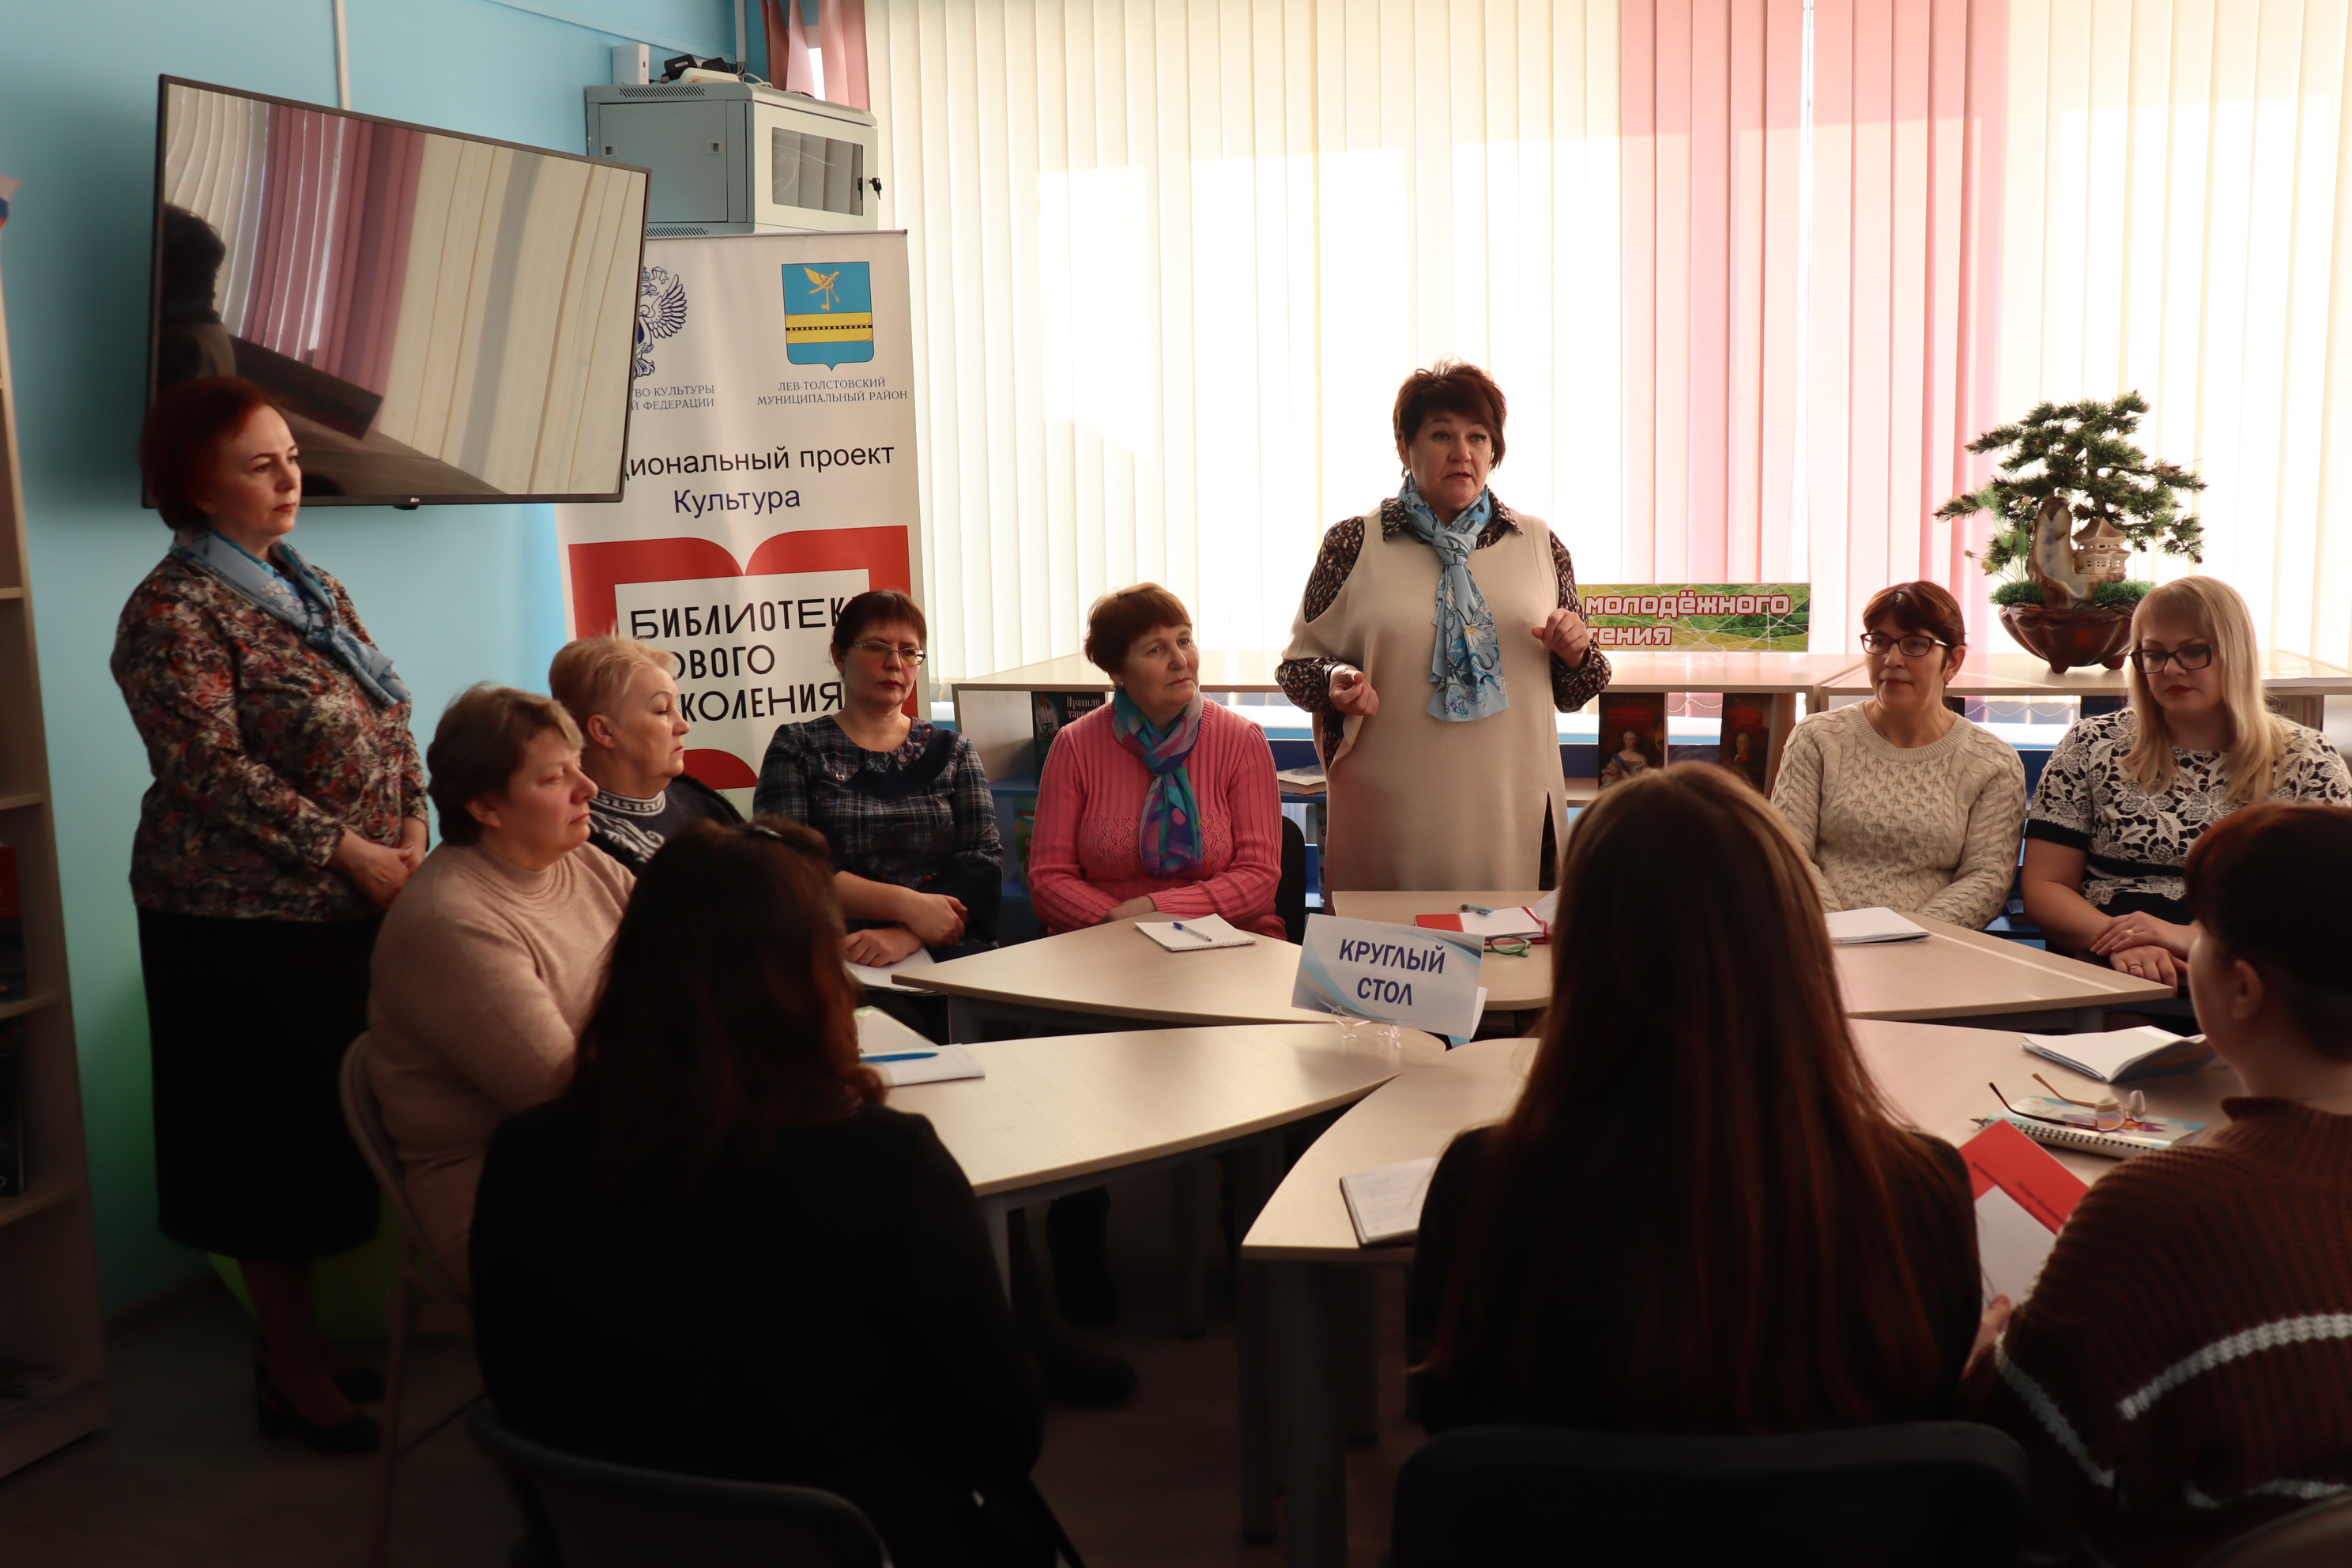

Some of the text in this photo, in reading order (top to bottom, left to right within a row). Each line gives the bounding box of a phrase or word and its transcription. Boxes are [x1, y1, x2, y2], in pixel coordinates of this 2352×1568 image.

[654, 384, 715, 398] КУЛЬТУРЫ
[757, 390, 908, 406] МУНИЦИПАЛЬНЫЙ РАЙОН
[778, 377, 886, 392] ЛЕВ-ТОЛСТОВСКИЙ
[643, 398, 714, 411] ФЕДЕРАЦИИ
[800, 445, 895, 473] проект
[674, 488, 801, 519] Культура
[631, 597, 846, 640] БИБЛИОТЕК
[1587, 626, 1672, 646] тения
[675, 644, 775, 681] ОВОГО
[680, 680, 843, 723] КОЛЕНИЯ
[1066, 695, 1100, 710] Правило
[1339, 937, 1446, 974] КРУГЛЫЙ
[1357, 976, 1413, 1006] СТОЛ
